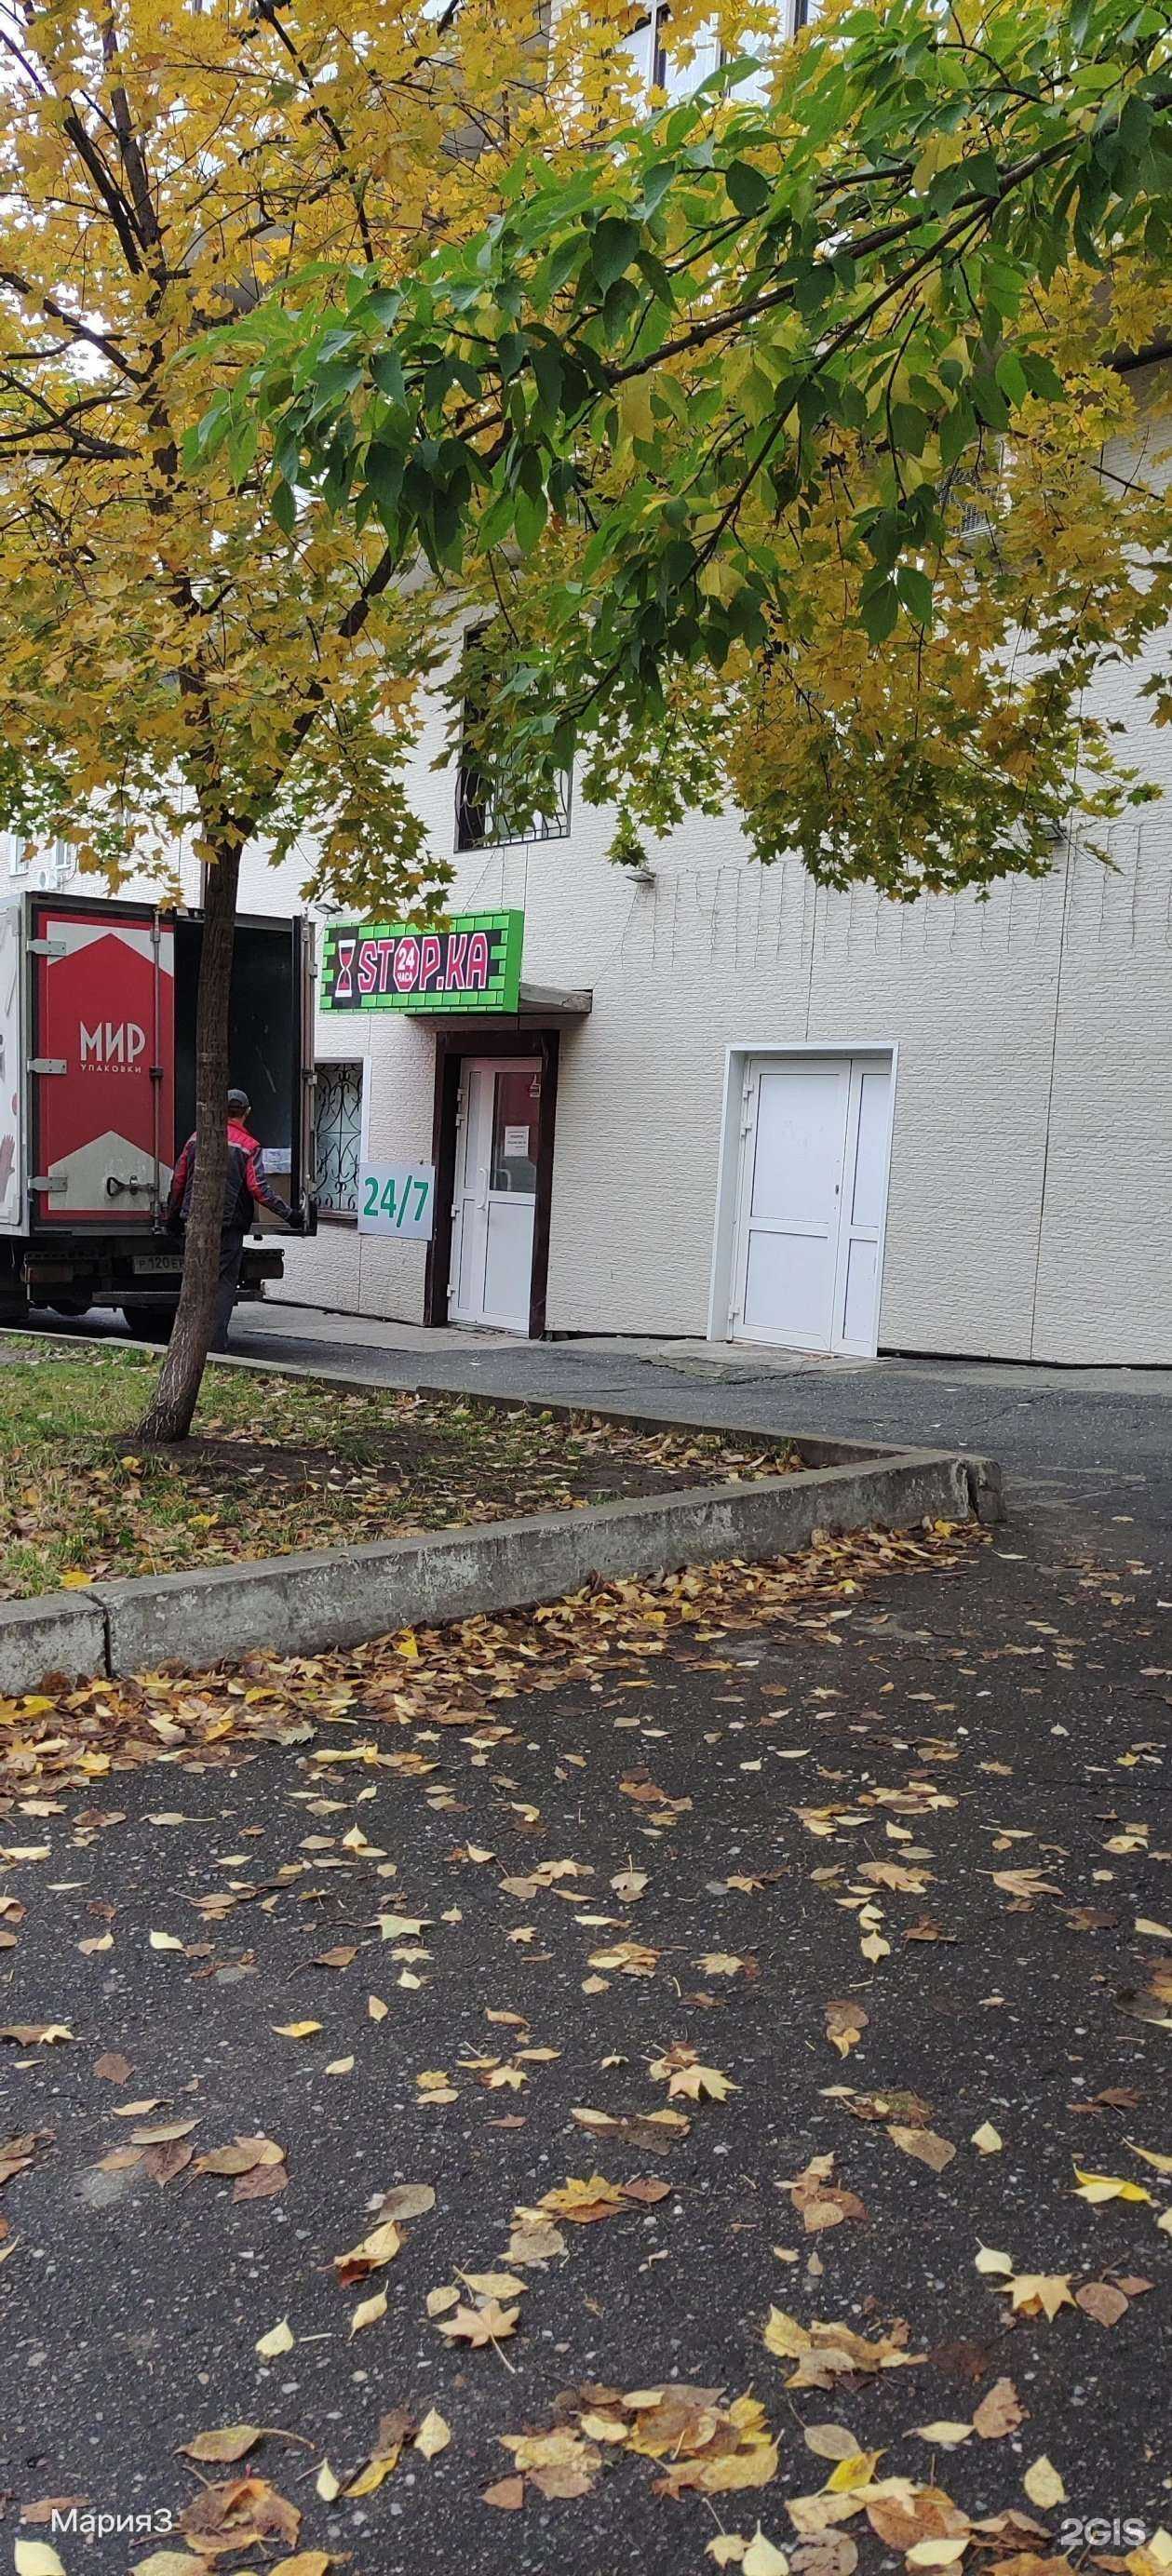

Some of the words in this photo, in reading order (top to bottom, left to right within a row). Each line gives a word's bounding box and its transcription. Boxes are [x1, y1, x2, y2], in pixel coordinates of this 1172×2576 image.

[397, 946, 415, 970] 24
[80, 1021, 145, 1063] МИР
[80, 1064, 141, 1073] УПАКОВКИ
[364, 1175, 428, 1228] 24/7
